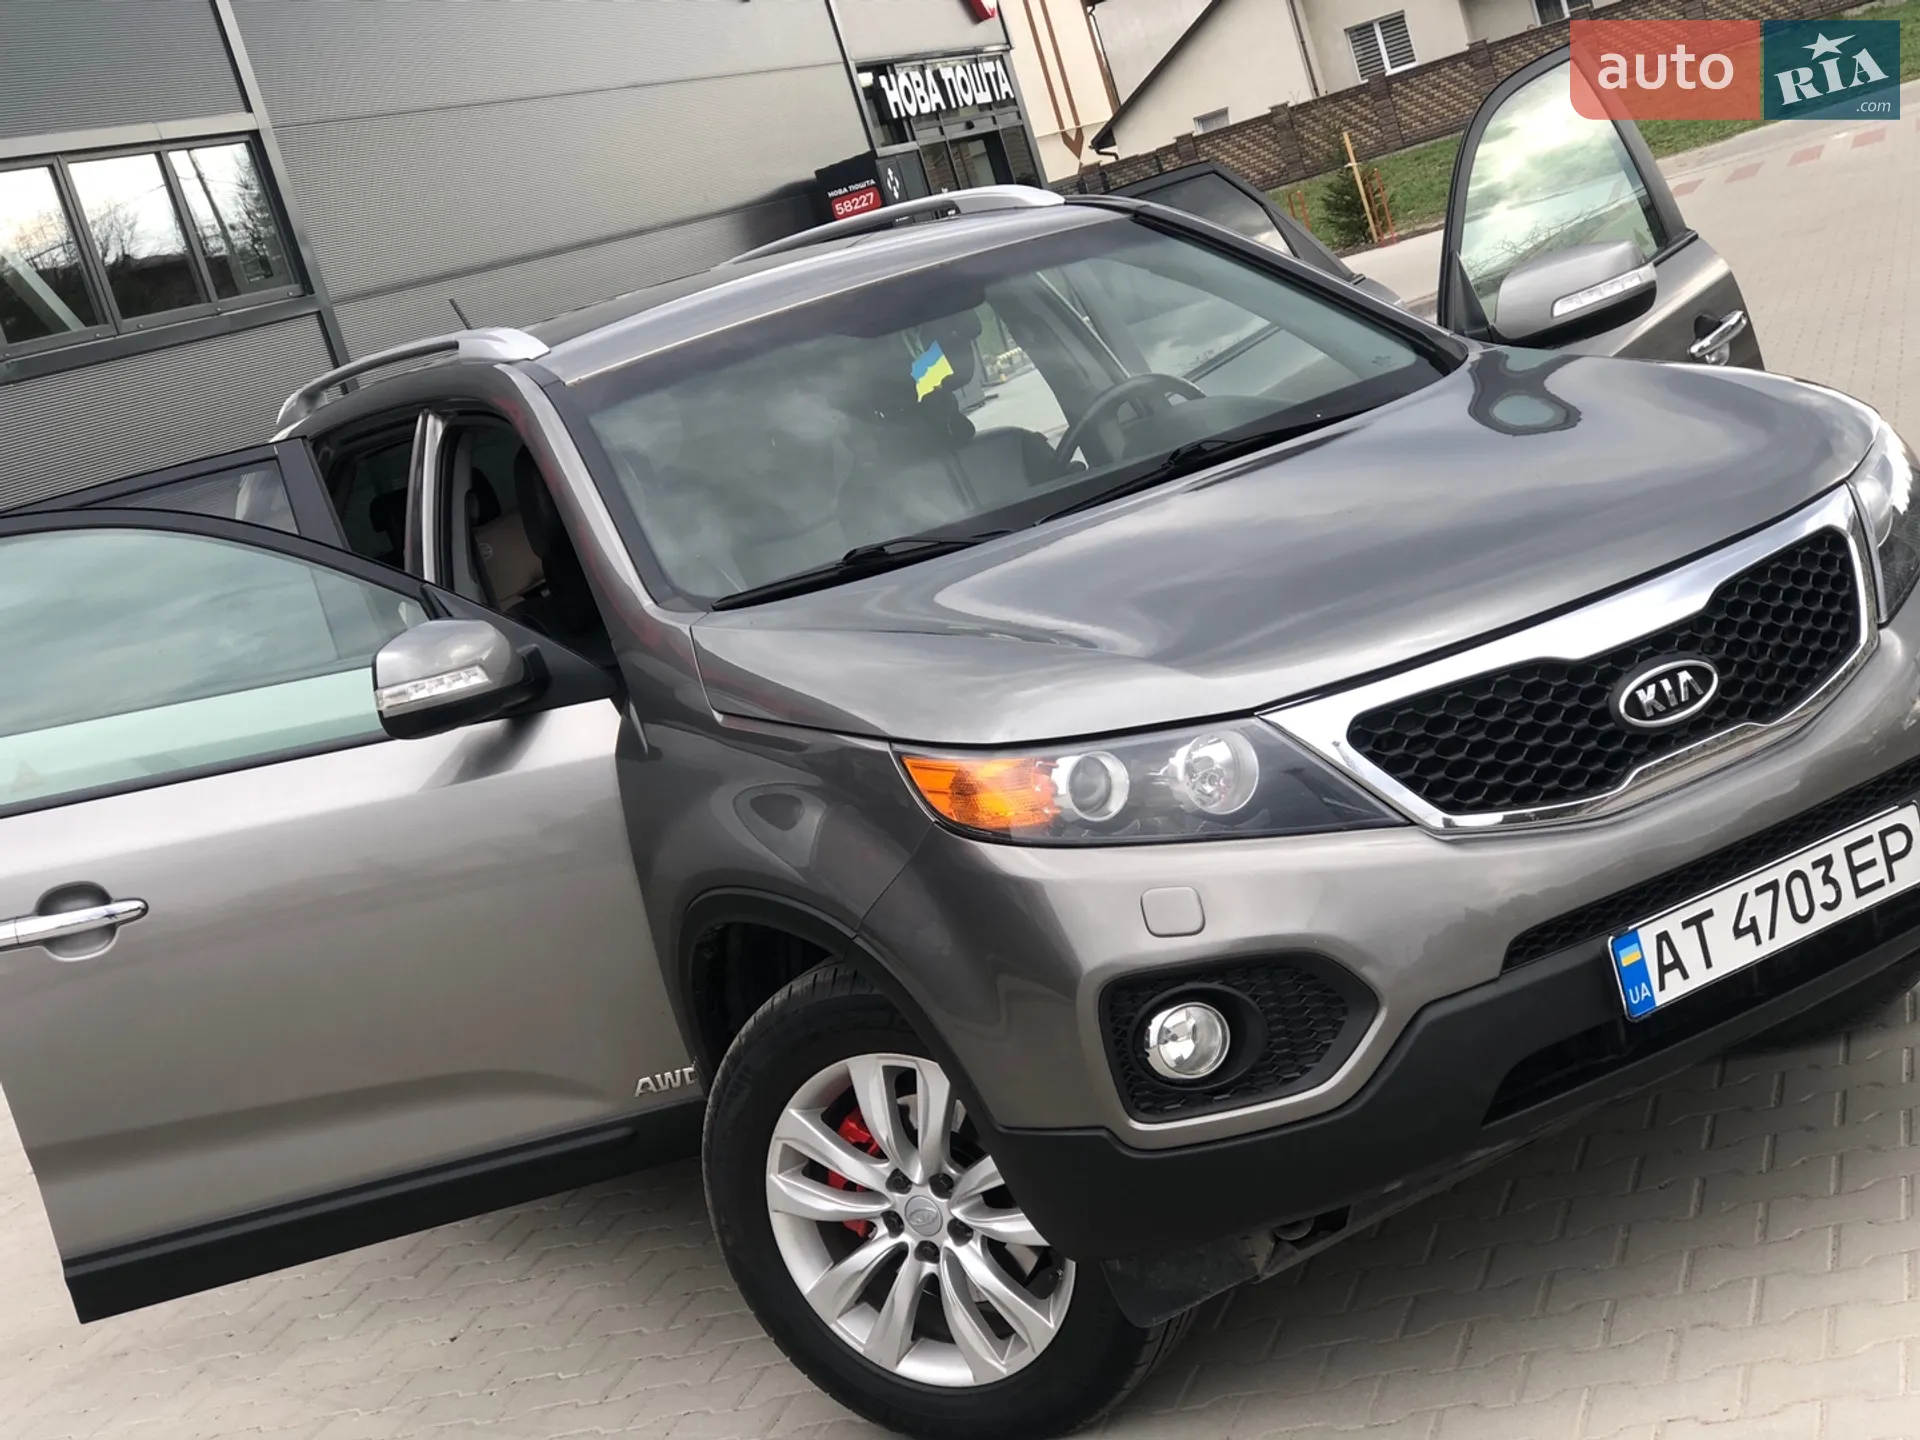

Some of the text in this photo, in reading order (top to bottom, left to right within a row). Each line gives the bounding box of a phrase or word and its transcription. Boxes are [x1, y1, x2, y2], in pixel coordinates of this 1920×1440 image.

[879, 60, 1014, 119] НОВА ПОШТА
[827, 179, 876, 198] НОВА ПОШТА
[835, 192, 874, 215] 58227
[1635, 670, 1704, 717] KIA
[1628, 981, 1652, 1005] UA
